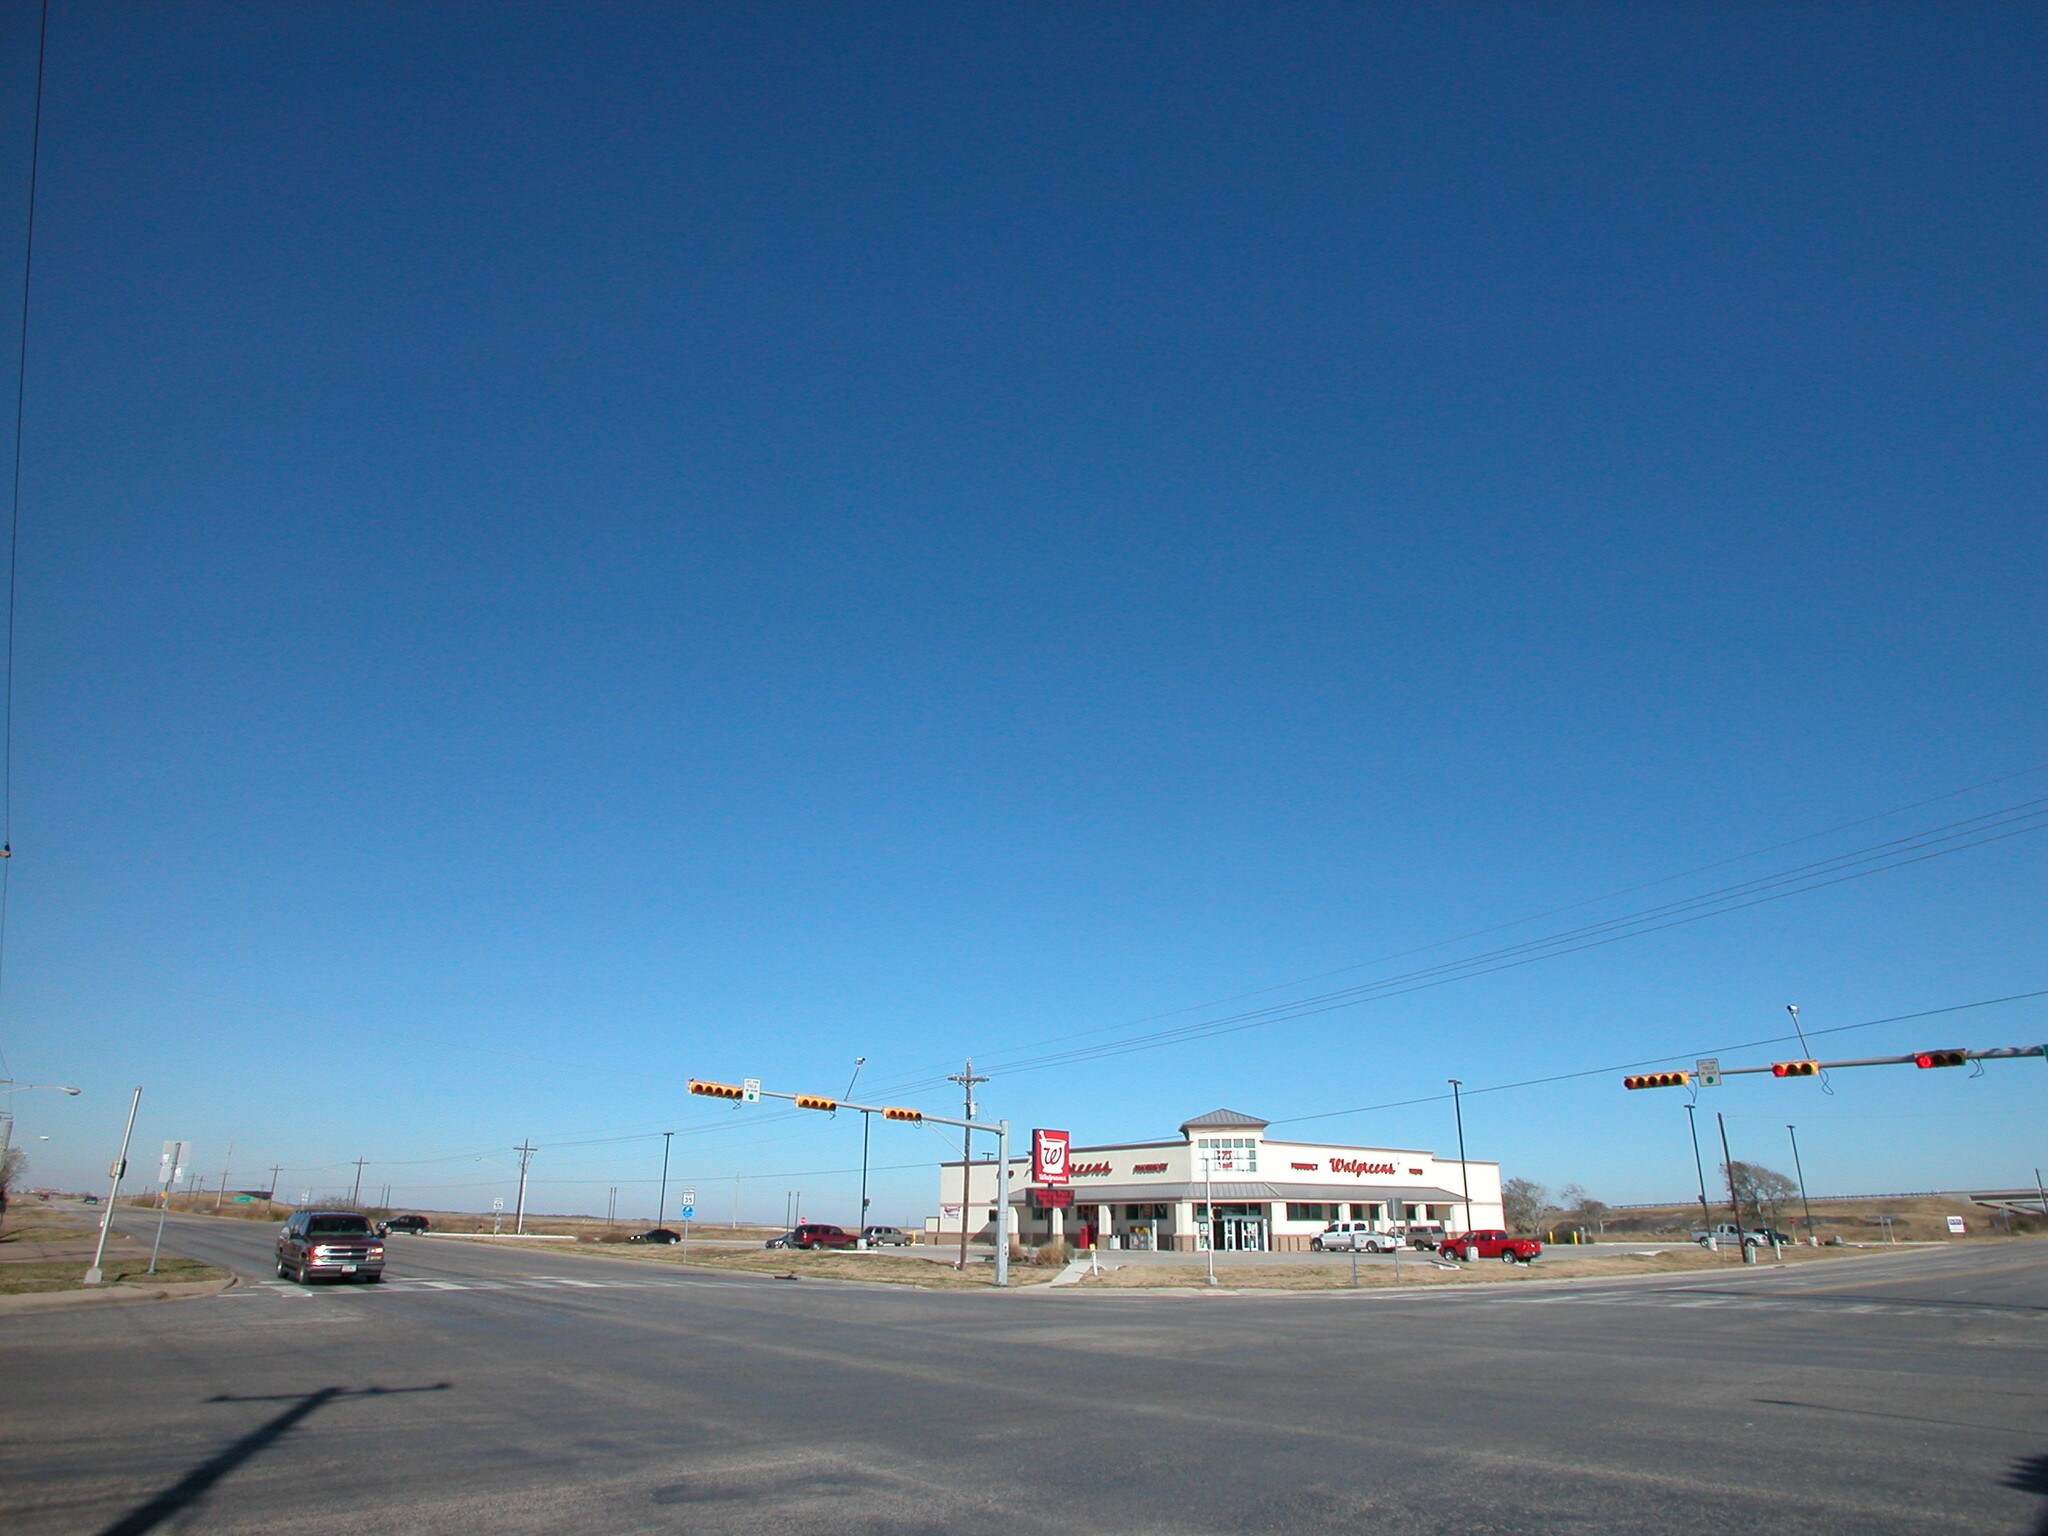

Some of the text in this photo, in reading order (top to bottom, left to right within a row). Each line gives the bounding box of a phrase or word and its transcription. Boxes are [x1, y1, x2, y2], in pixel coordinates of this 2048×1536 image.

[1043, 1147, 1062, 1165] W
[1069, 1161, 1113, 1178] reens
[1329, 1158, 1396, 1178] Walgreens
[1038, 1174, 1067, 1183] Walgreens
